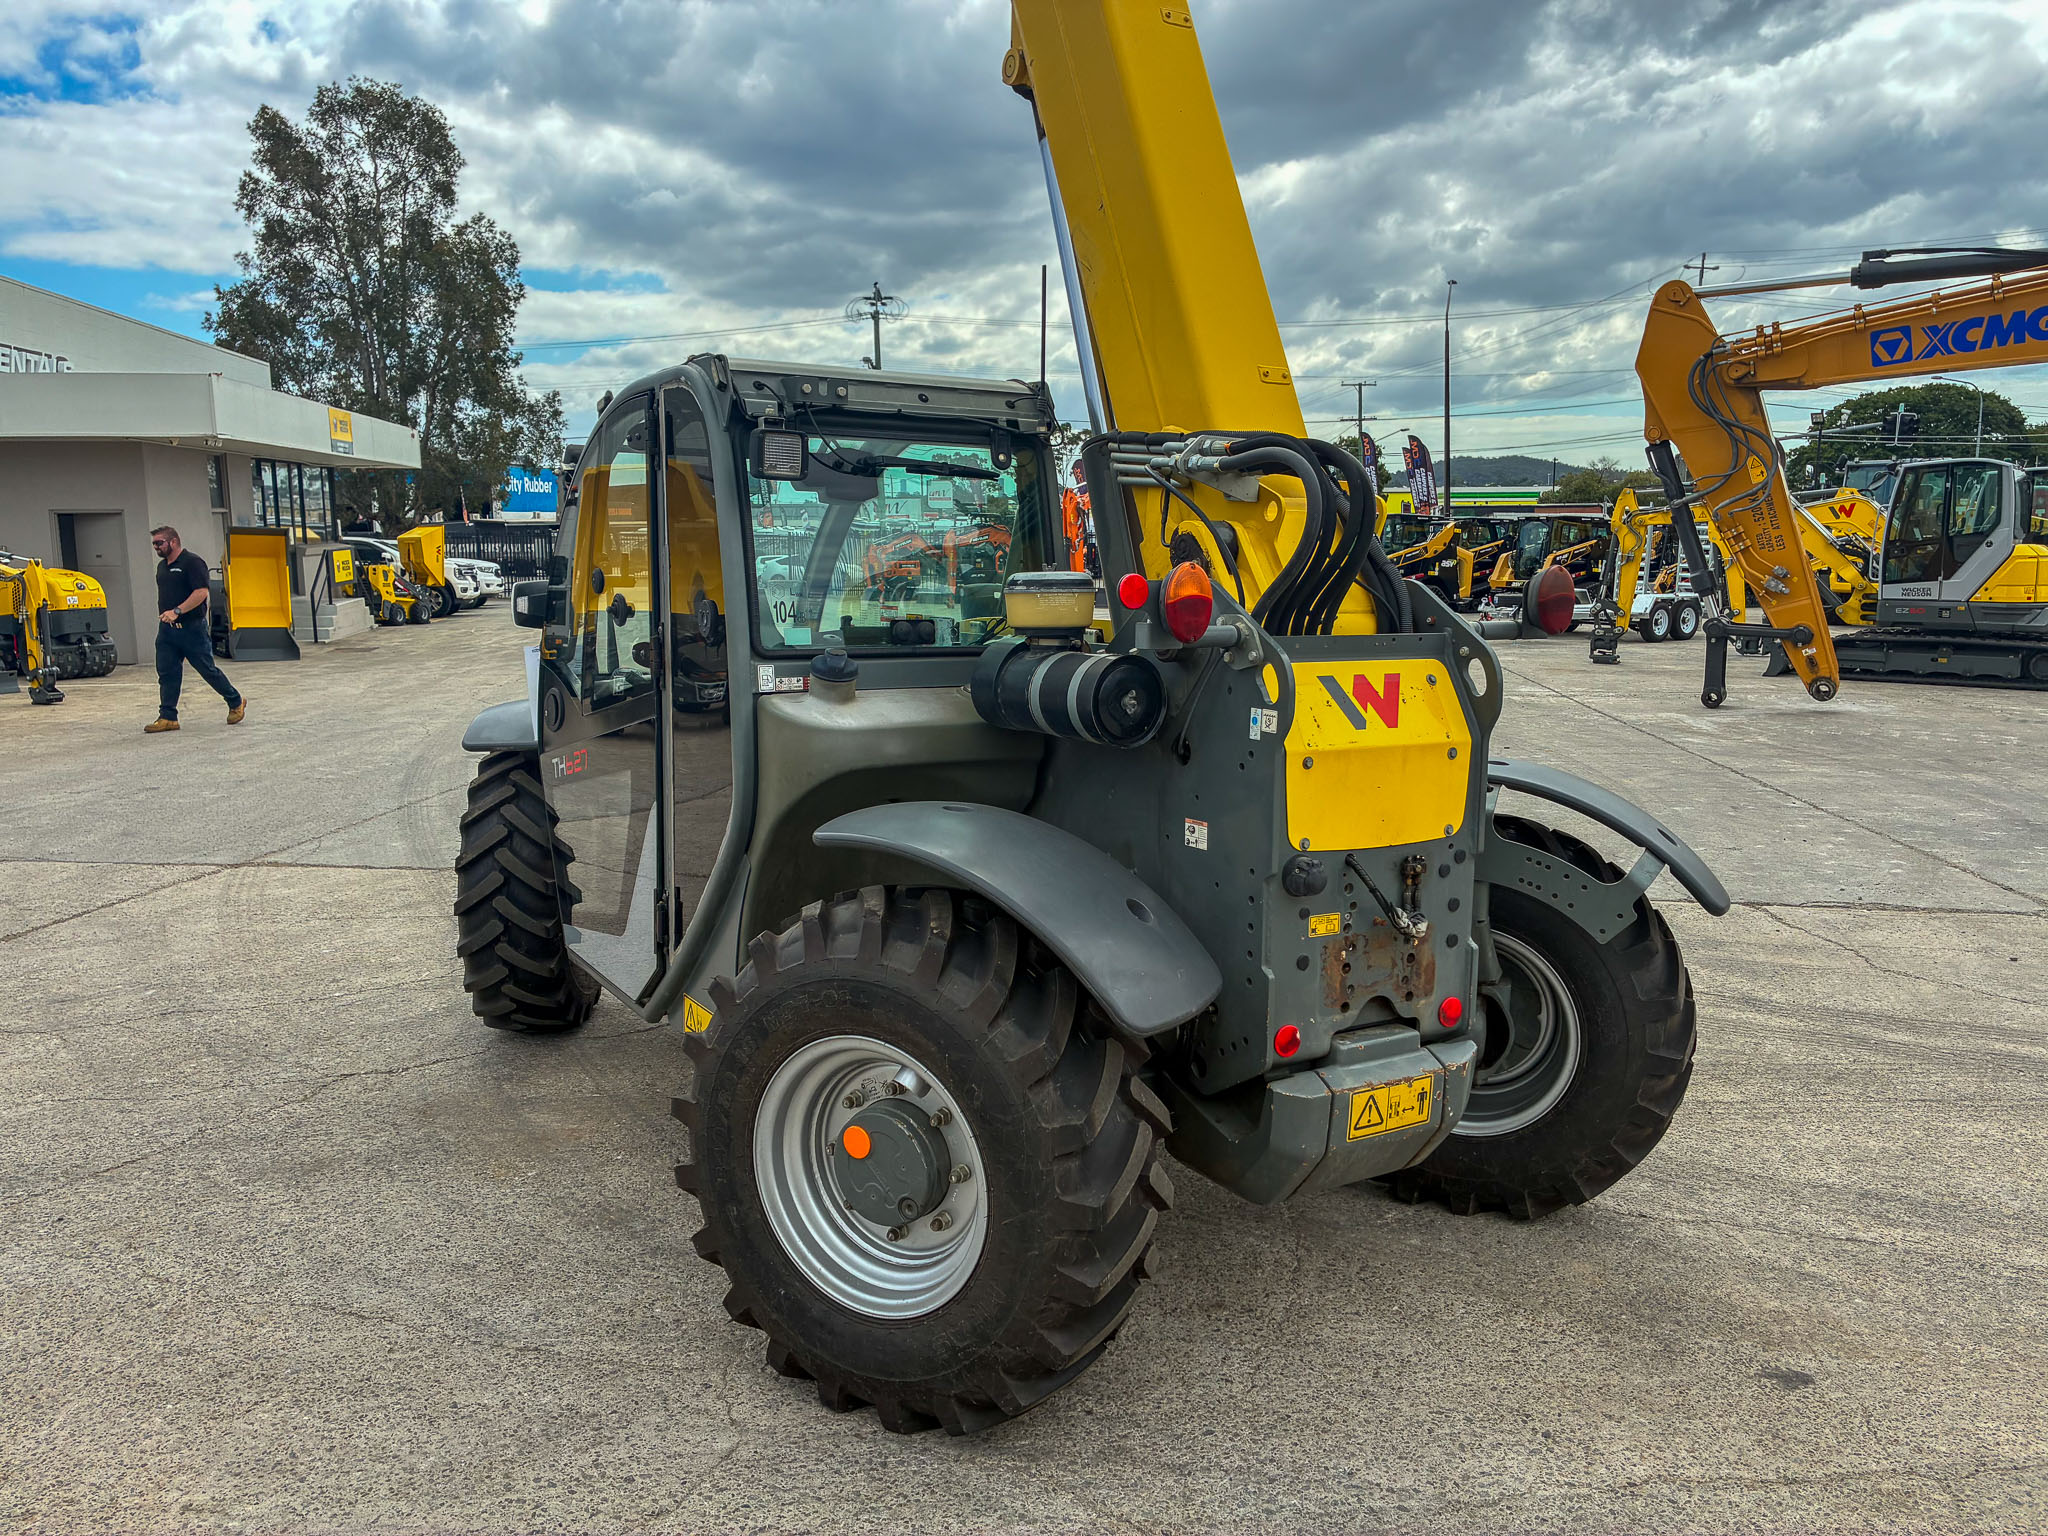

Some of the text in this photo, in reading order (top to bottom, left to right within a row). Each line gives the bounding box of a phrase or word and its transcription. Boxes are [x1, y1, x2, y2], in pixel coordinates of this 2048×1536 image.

[523, 476, 553, 494] Rubber
[1774, 534, 1786, 551] LESS
[773, 600, 797, 624] 104
[551, 749, 588, 778] TH627
